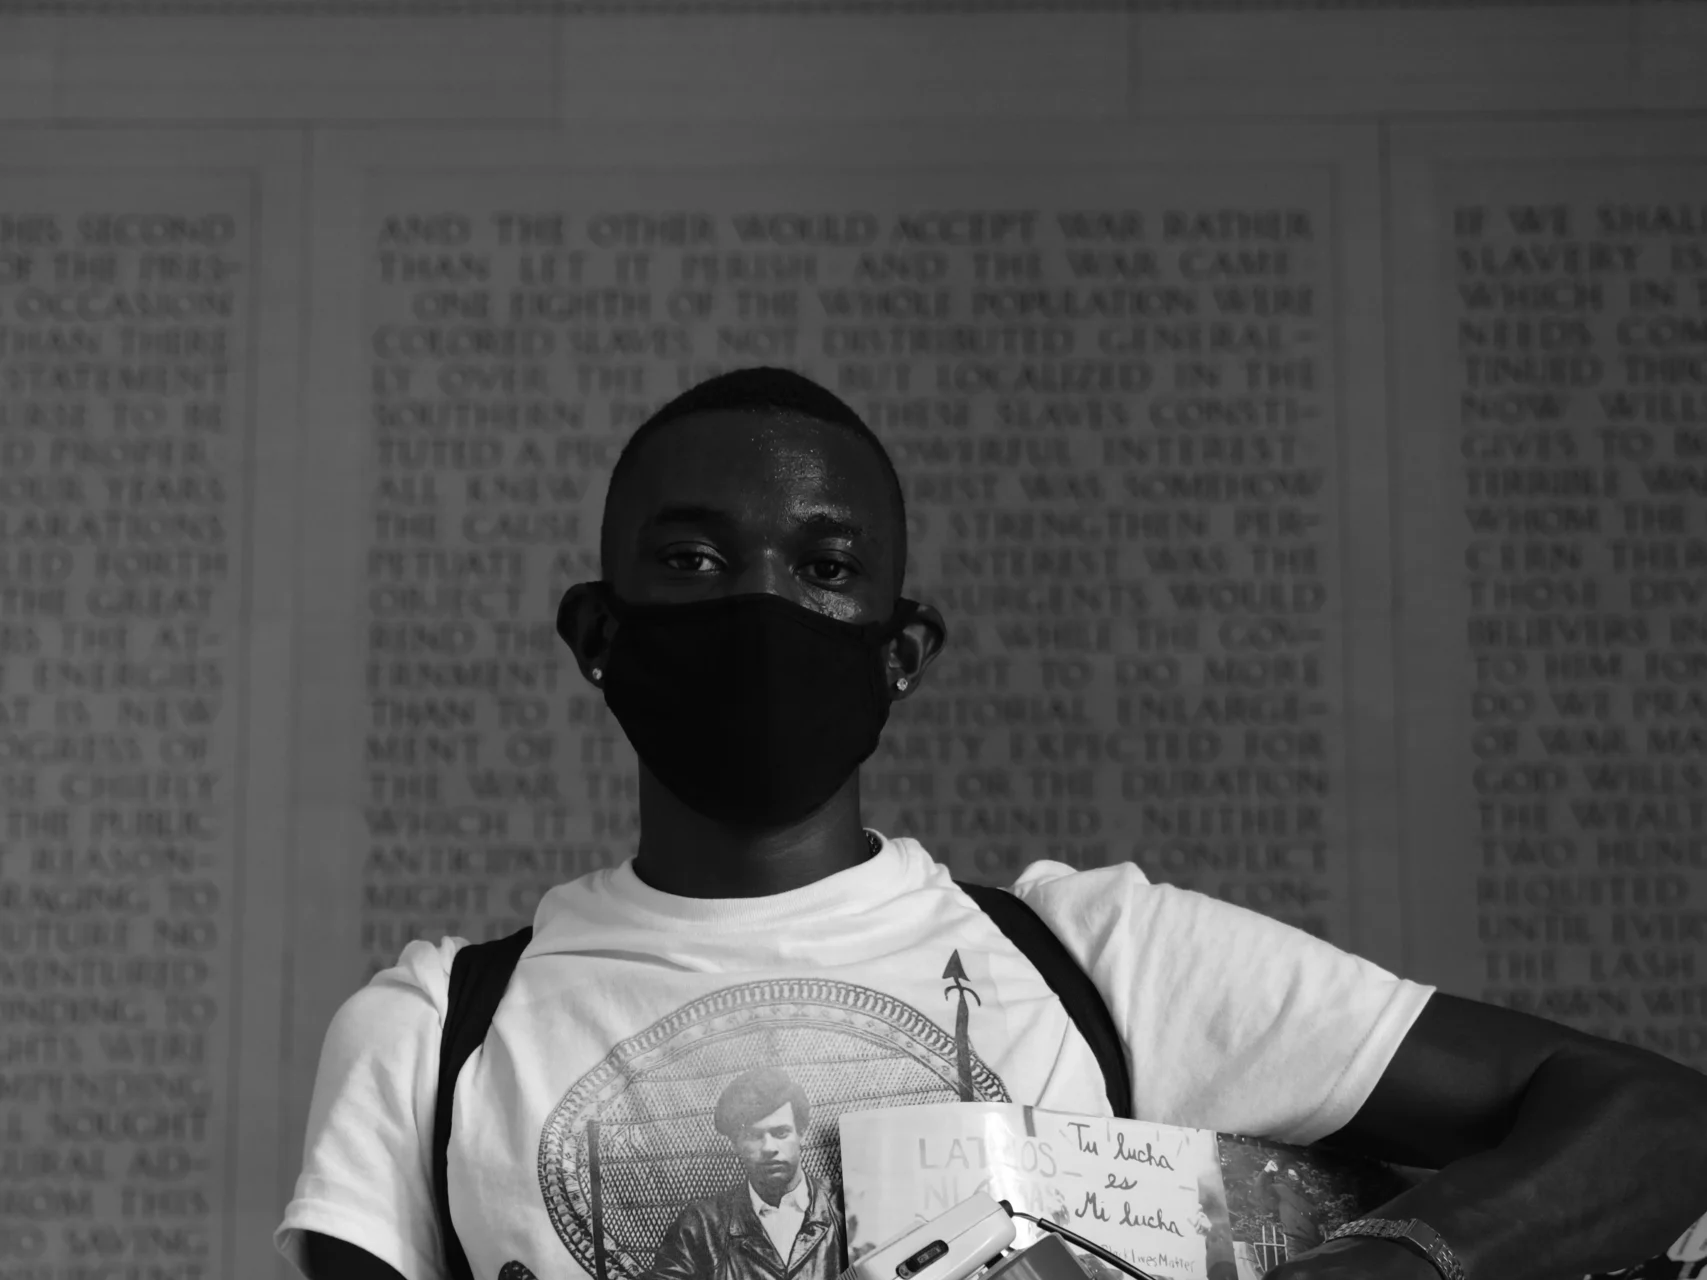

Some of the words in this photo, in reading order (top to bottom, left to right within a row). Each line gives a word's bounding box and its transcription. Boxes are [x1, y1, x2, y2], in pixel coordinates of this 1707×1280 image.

[1066, 1120, 1100, 1157] Tu
[1113, 1132, 1176, 1173] lucha
[1104, 1172, 1138, 1191] es
[1074, 1191, 1111, 1223] Mi
[1122, 1207, 1186, 1238] lucha
